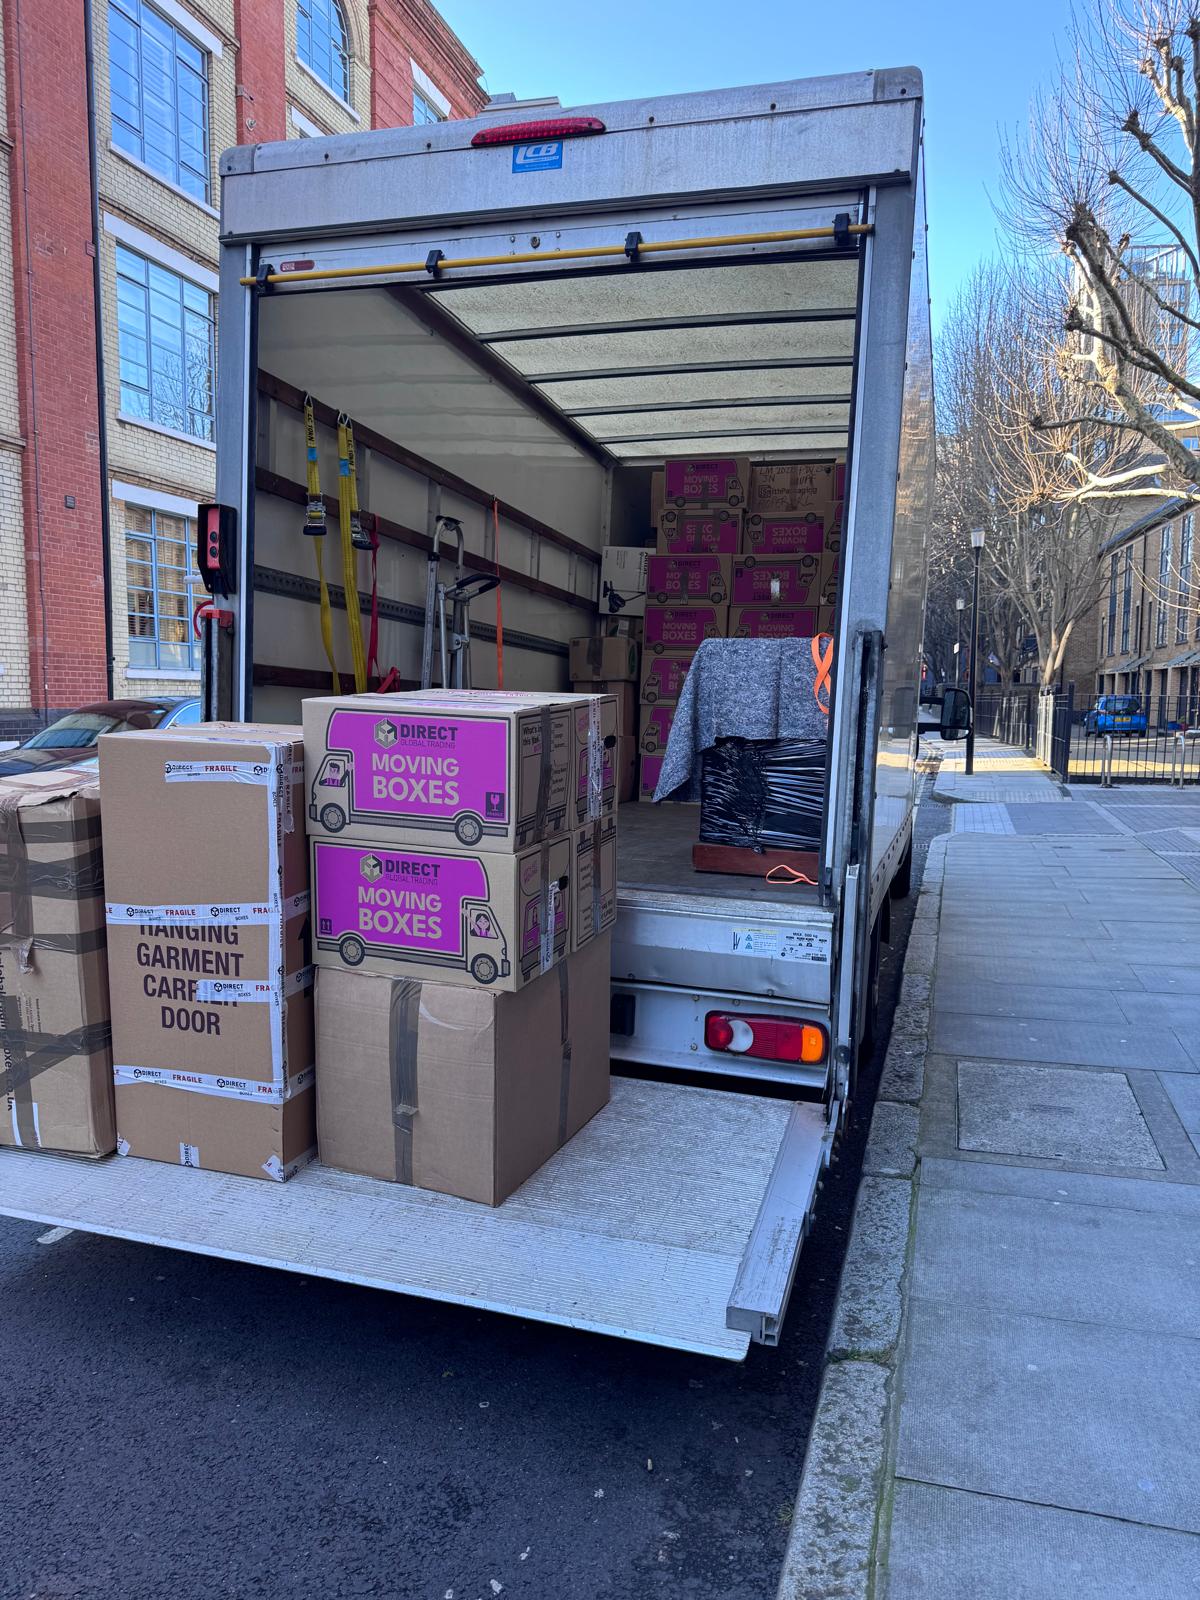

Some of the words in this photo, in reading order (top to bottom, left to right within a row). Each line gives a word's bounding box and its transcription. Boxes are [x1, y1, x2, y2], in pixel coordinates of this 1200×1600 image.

[772, 527, 808, 536] BOXES
[772, 536, 808, 545] MOVING
[666, 580, 701, 590] BOES
[662, 631, 697, 640] BOXES
[663, 623, 697, 631] MOVING
[400, 724, 458, 741] DIRECT
[427, 741, 456, 749] TRADING
[372, 753, 459, 776] MOVING
[373, 776, 460, 806] BOXES
[385, 860, 440, 878] DIRECT
[358, 886, 442, 912] MOVING
[359, 908, 442, 939] BOXES
[136, 942, 244, 977] GARMENT
[161, 1006, 220, 1036] DOOR
[172, 1074, 203, 1083] FRAGILE
